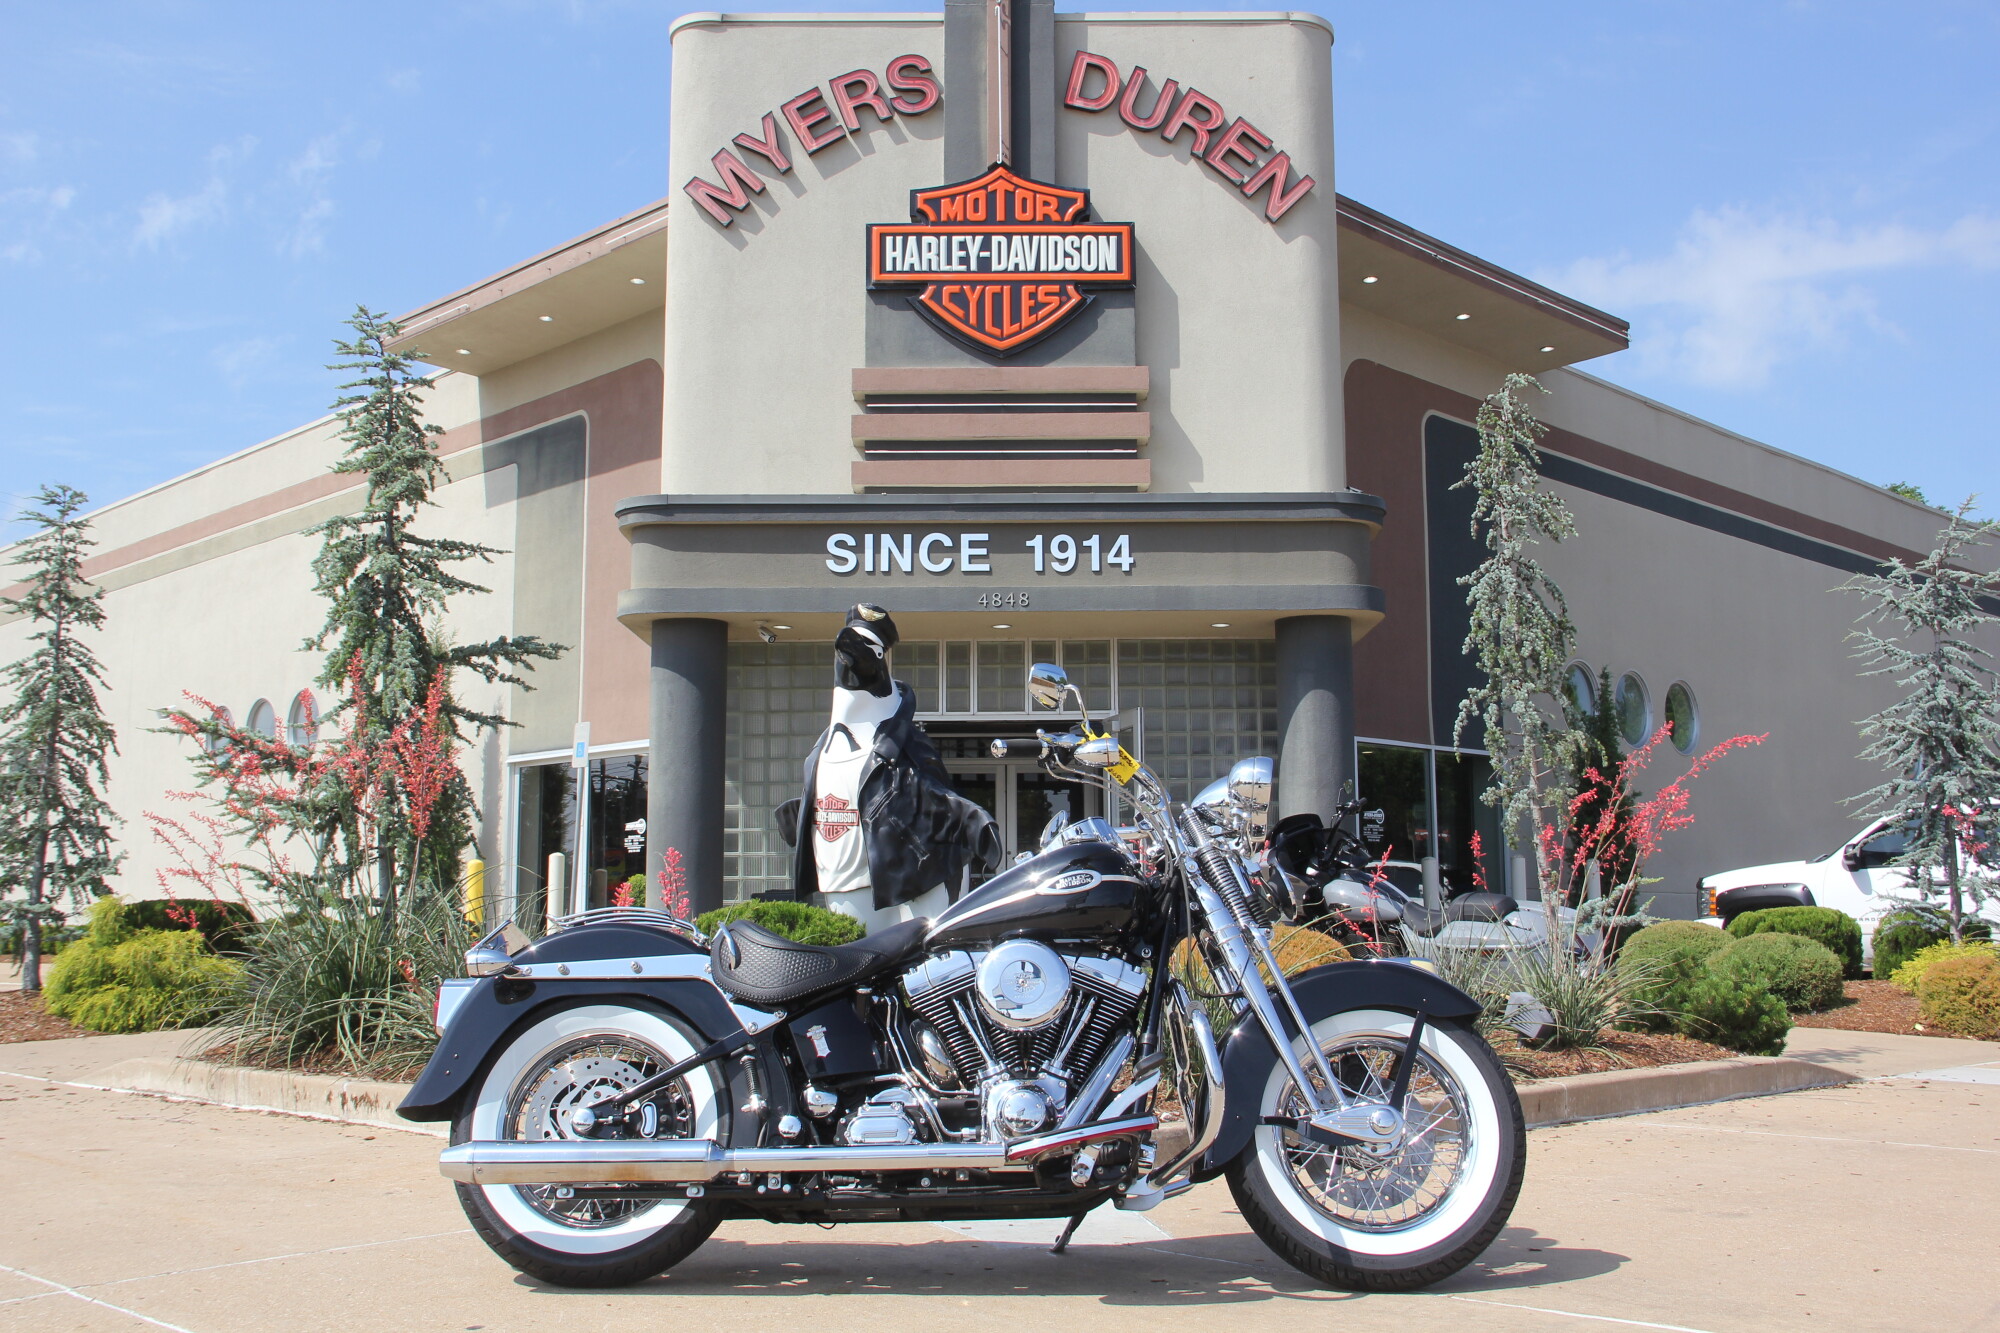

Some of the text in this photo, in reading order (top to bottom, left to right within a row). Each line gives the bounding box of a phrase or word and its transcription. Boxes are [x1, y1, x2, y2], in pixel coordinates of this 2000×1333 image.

[683, 49, 1317, 228] MYERS DUREN
[940, 178, 1062, 222] MOTOR
[885, 235, 1118, 272] HARLEY-DAVIDSON
[942, 284, 1061, 338] CYCLES
[825, 532, 1135, 574] SINCE 1914
[978, 592, 1030, 608] 4848
